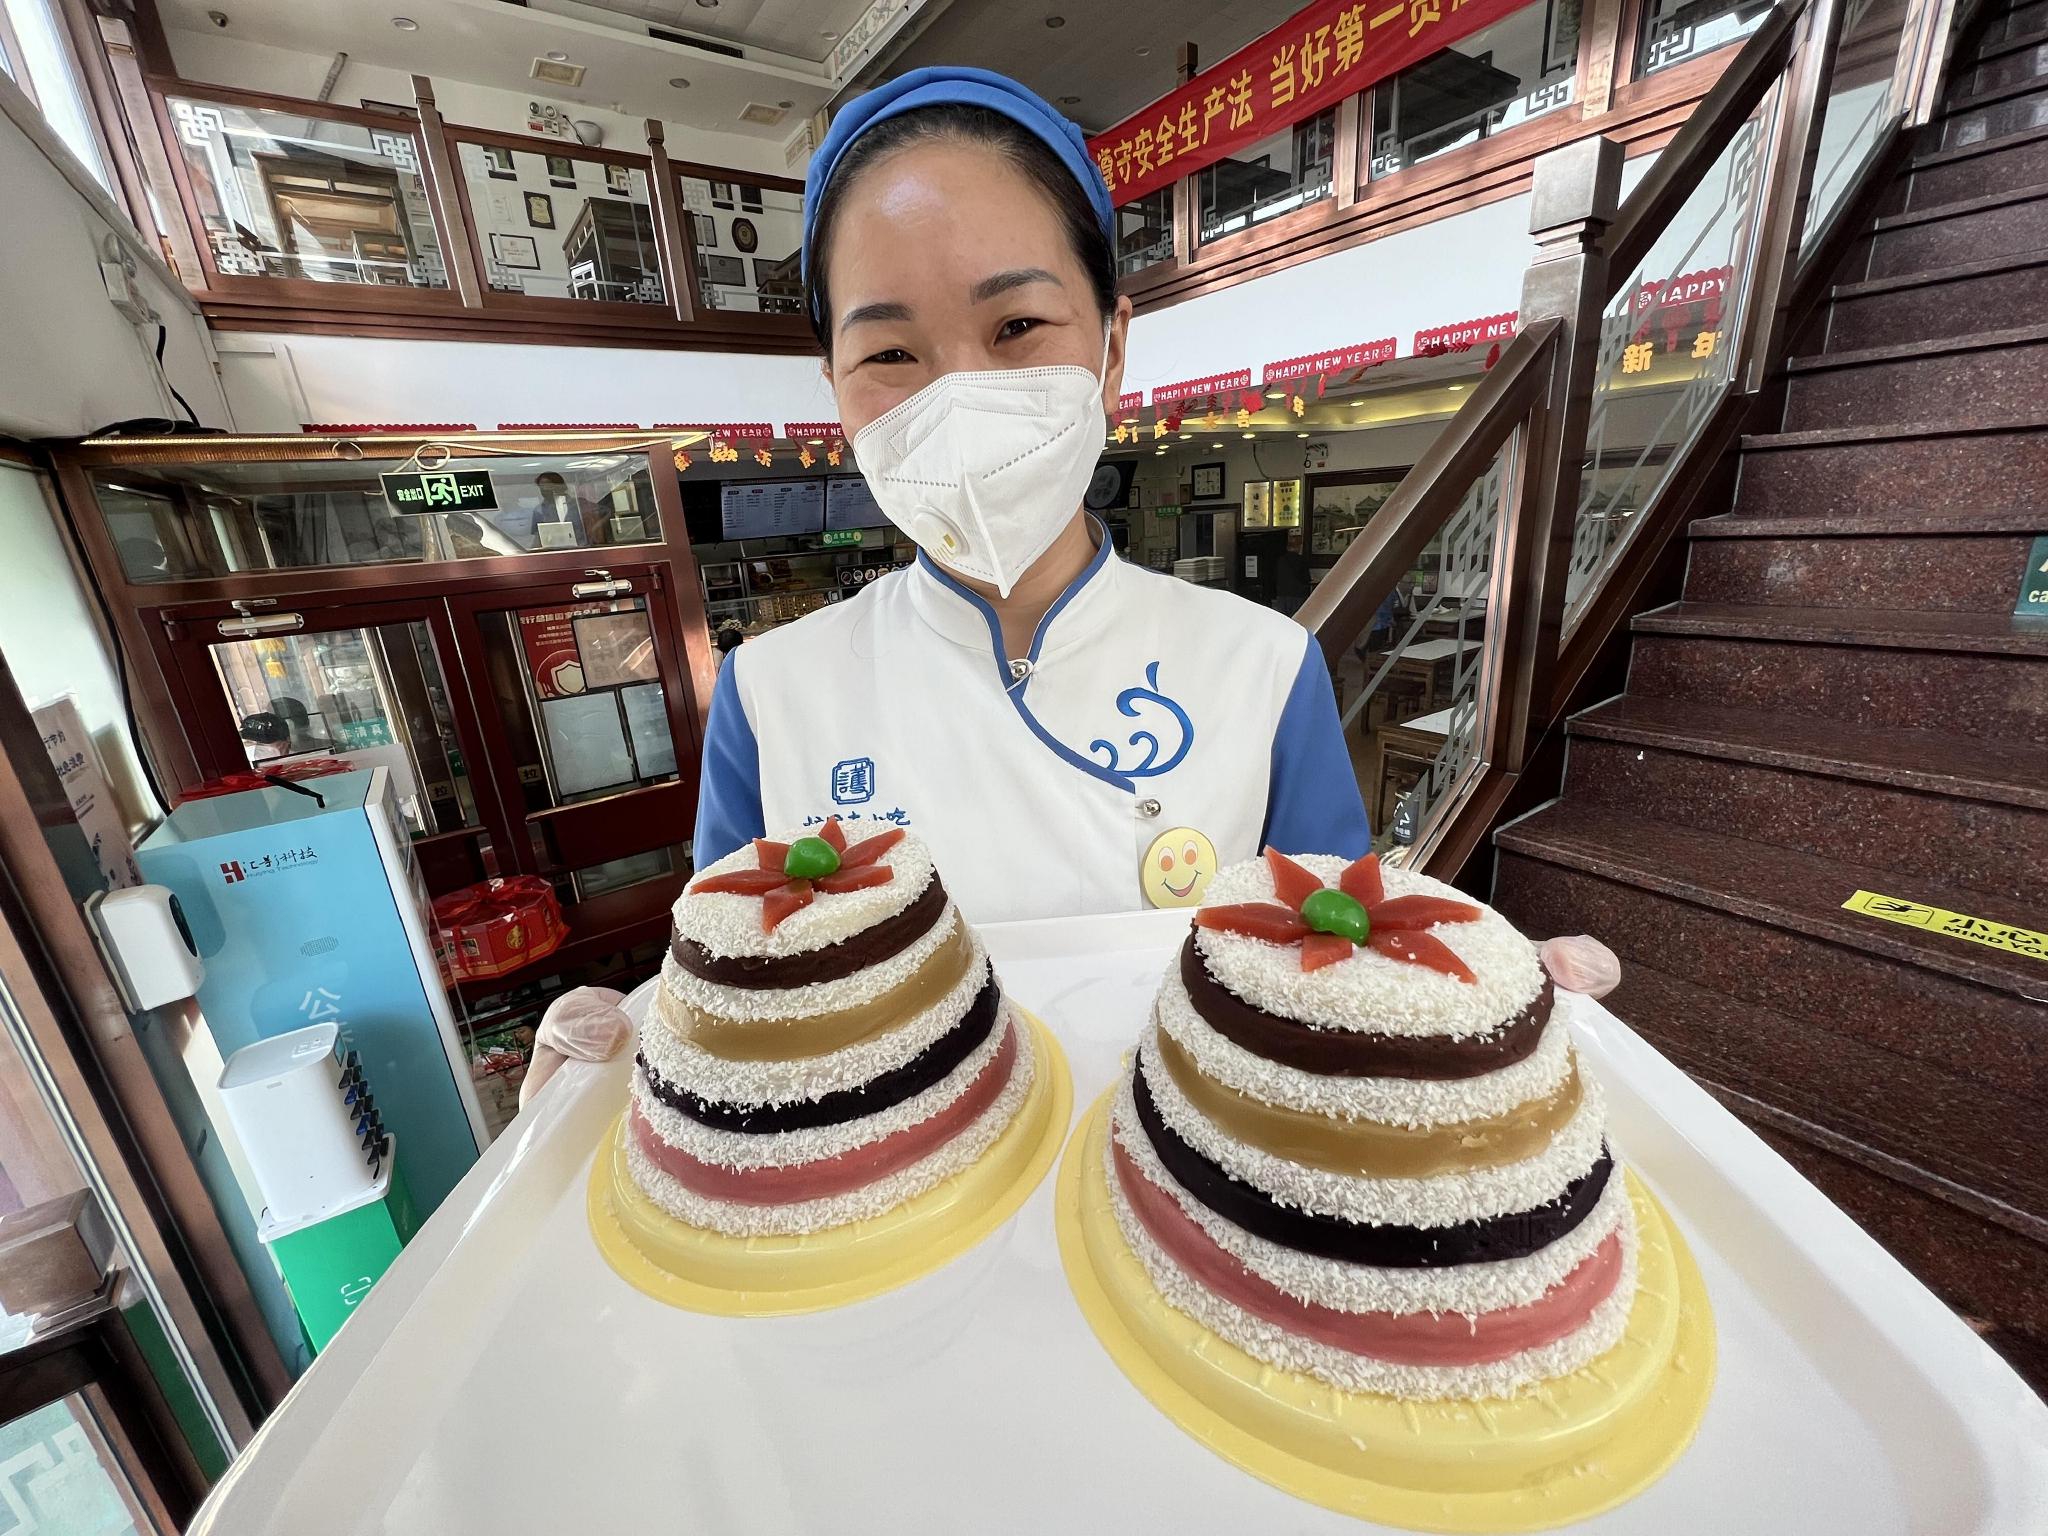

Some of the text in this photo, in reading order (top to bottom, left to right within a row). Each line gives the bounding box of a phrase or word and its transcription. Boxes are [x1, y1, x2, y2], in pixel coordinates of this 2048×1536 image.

[1098, 0, 1470, 192] 遵守安全生产法 当好第一
[1431, 327, 1481, 348] HAPPY
[1275, 348, 1380, 379] HAPPY NEW YEAR
[1191, 380, 1212, 395] NEW
[1214, 377, 1240, 391] YEAR
[1119, 398, 1135, 410] EAR
[735, 428, 763, 438] YEAR
[796, 427, 843, 437] HAPPY NE
[460, 484, 484, 498] EXIT
[1942, 925, 2048, 957] MIND YO
[1947, 918, 2043, 945] 小心
